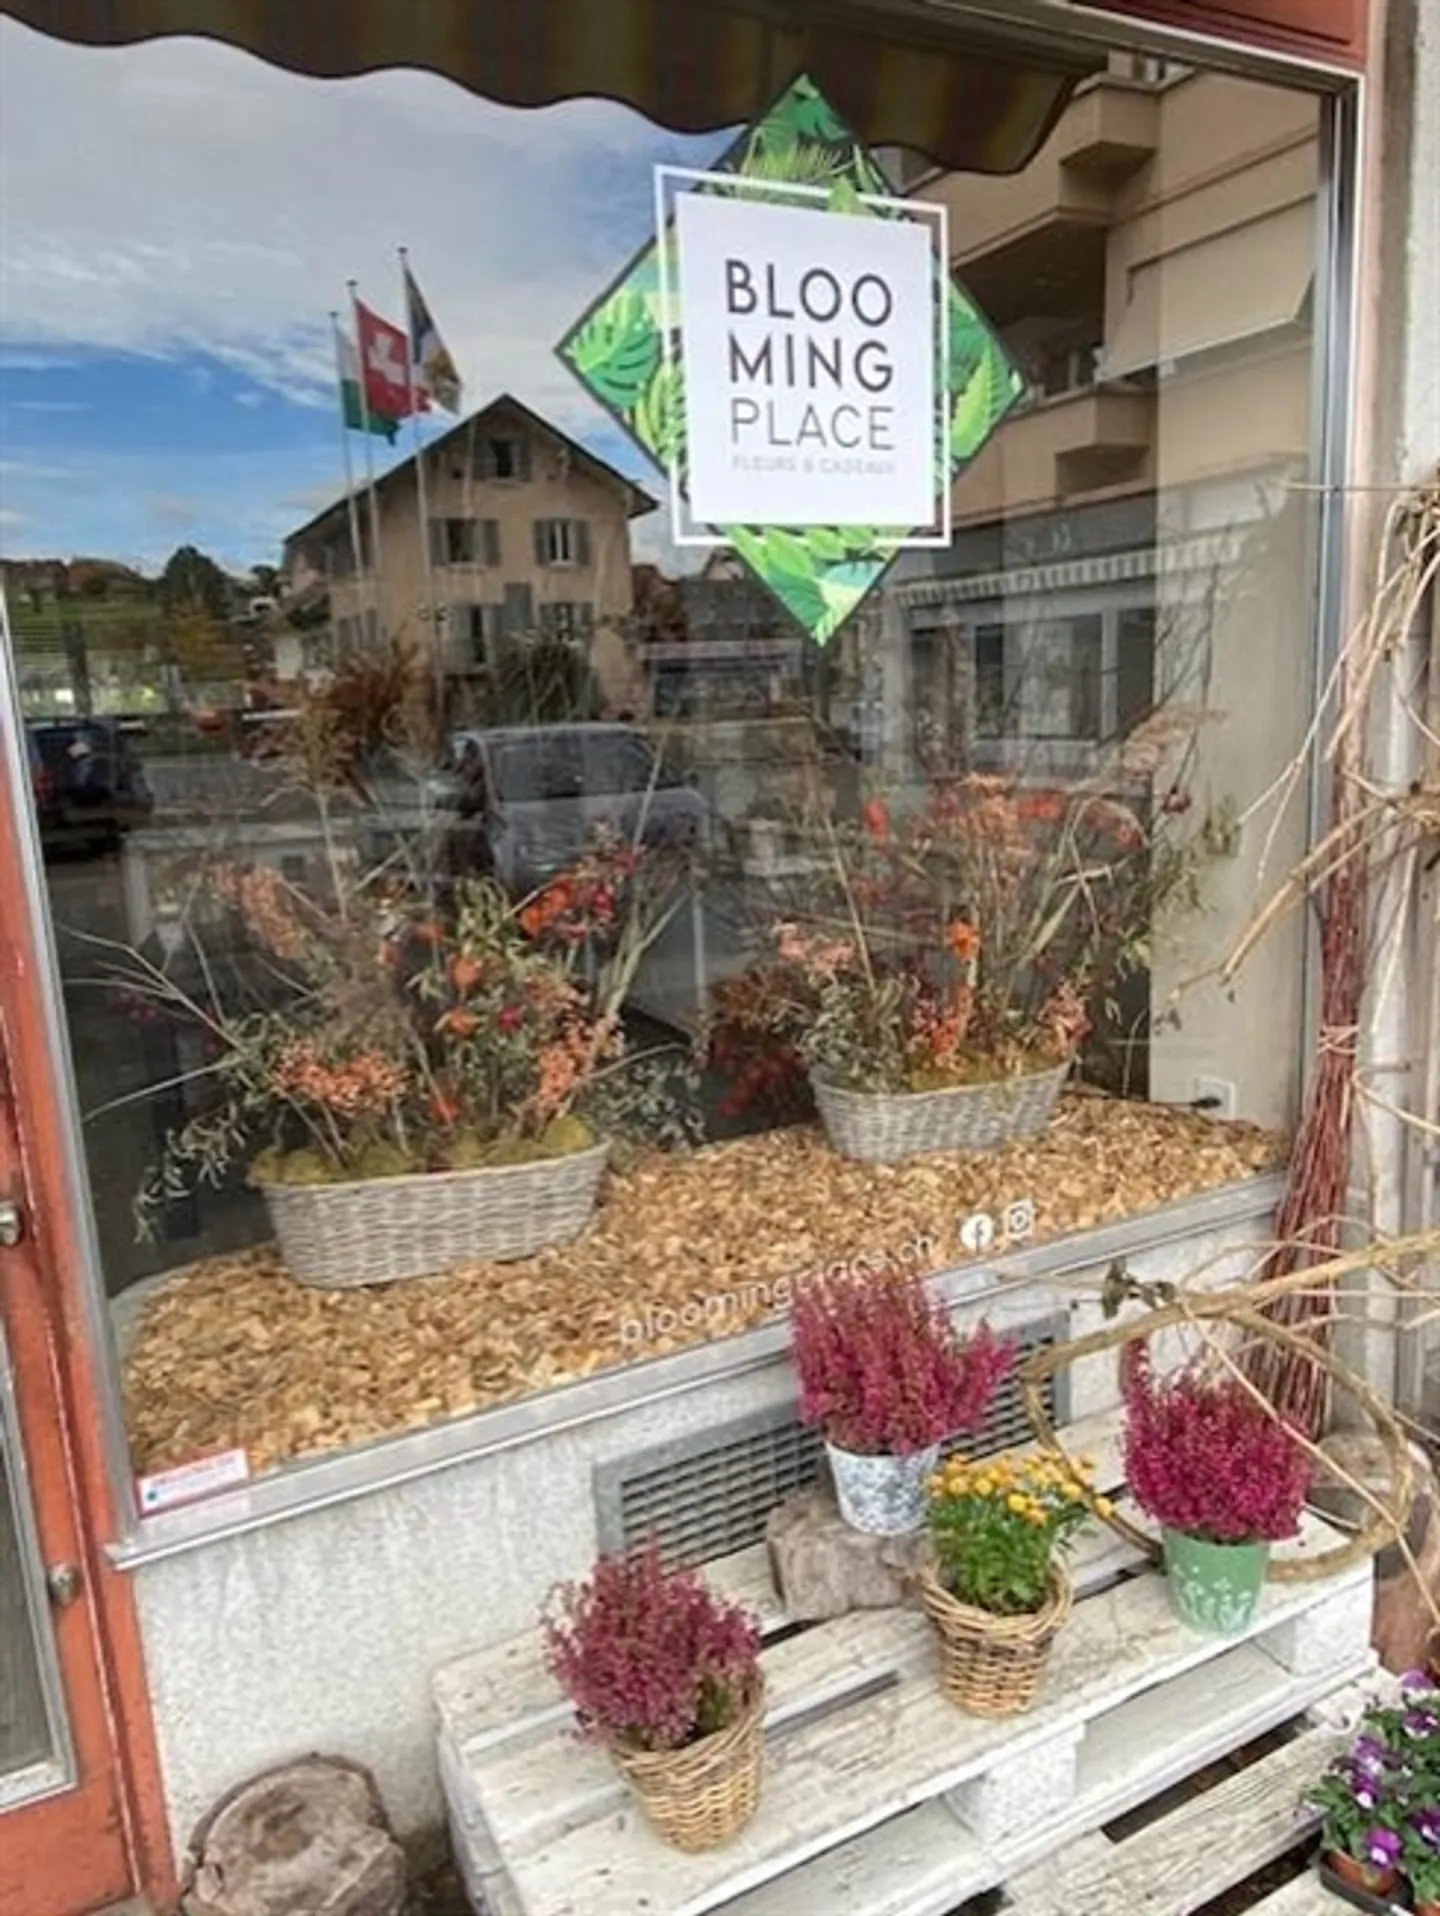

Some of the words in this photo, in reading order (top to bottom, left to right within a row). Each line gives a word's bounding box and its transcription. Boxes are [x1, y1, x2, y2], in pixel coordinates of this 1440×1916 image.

[725, 258, 892, 327] BLOO
[728, 331, 893, 393] MING
[731, 398, 895, 451] PLACE
